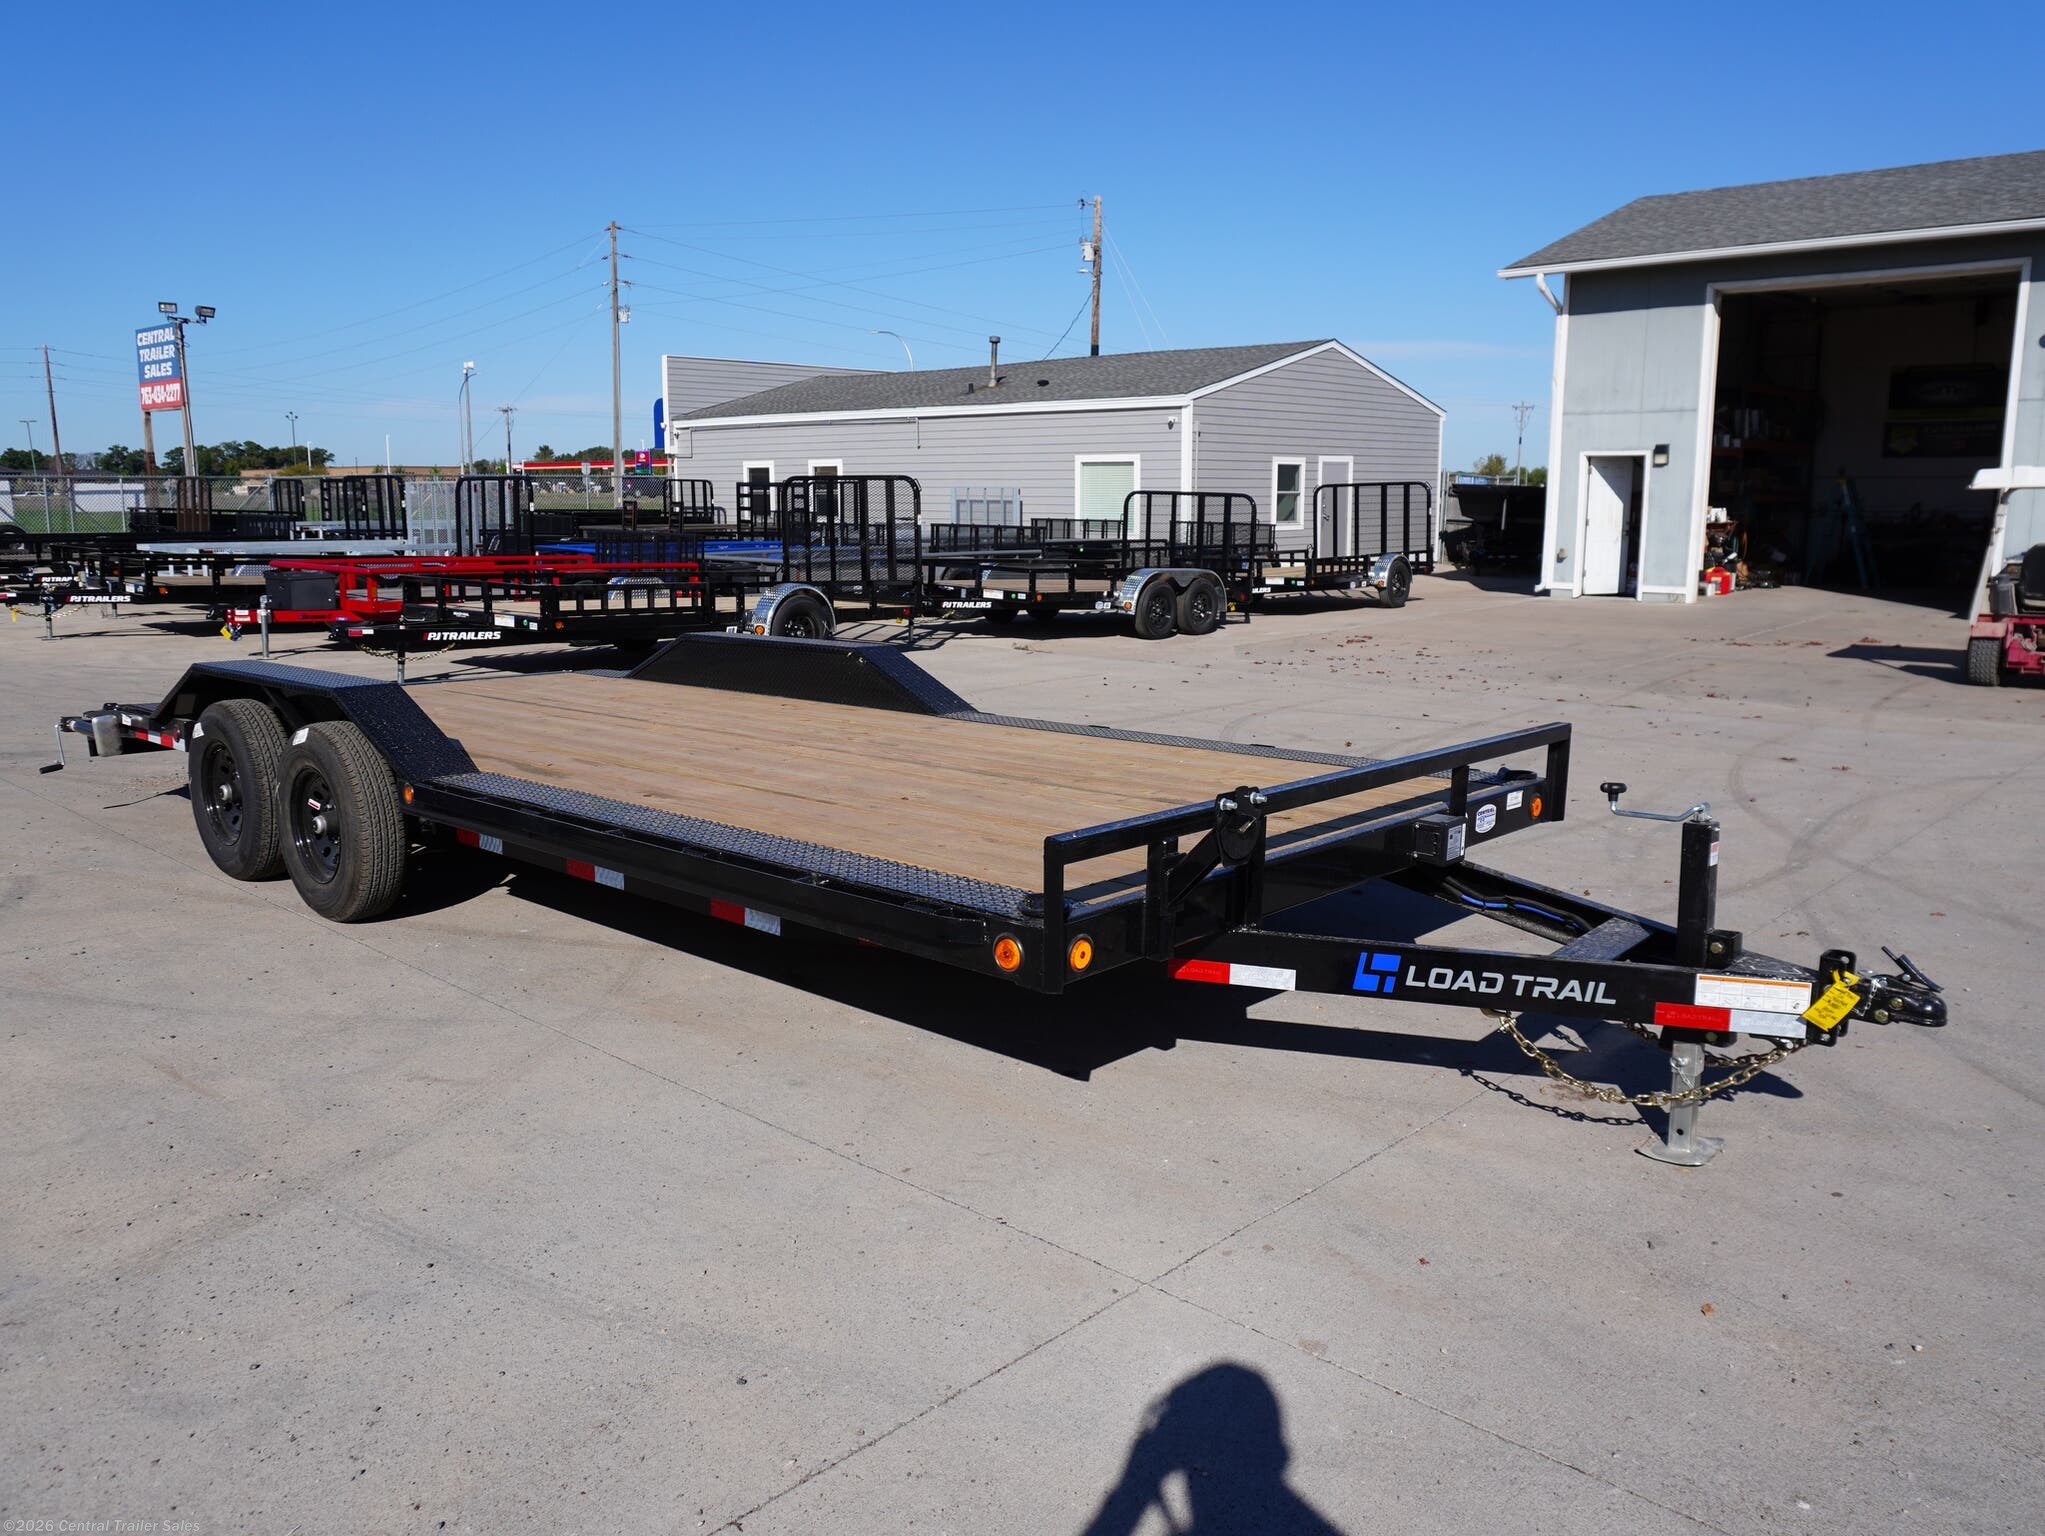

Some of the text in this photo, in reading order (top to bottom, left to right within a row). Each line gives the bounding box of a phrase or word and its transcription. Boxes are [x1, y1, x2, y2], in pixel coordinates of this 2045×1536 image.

[137, 327, 175, 346] CENTRAL
[139, 344, 176, 363] TRAILER
[144, 362, 173, 379] SALES
[1405, 965, 1504, 994] LOAD
[1512, 974, 1617, 1005] TRAIL
